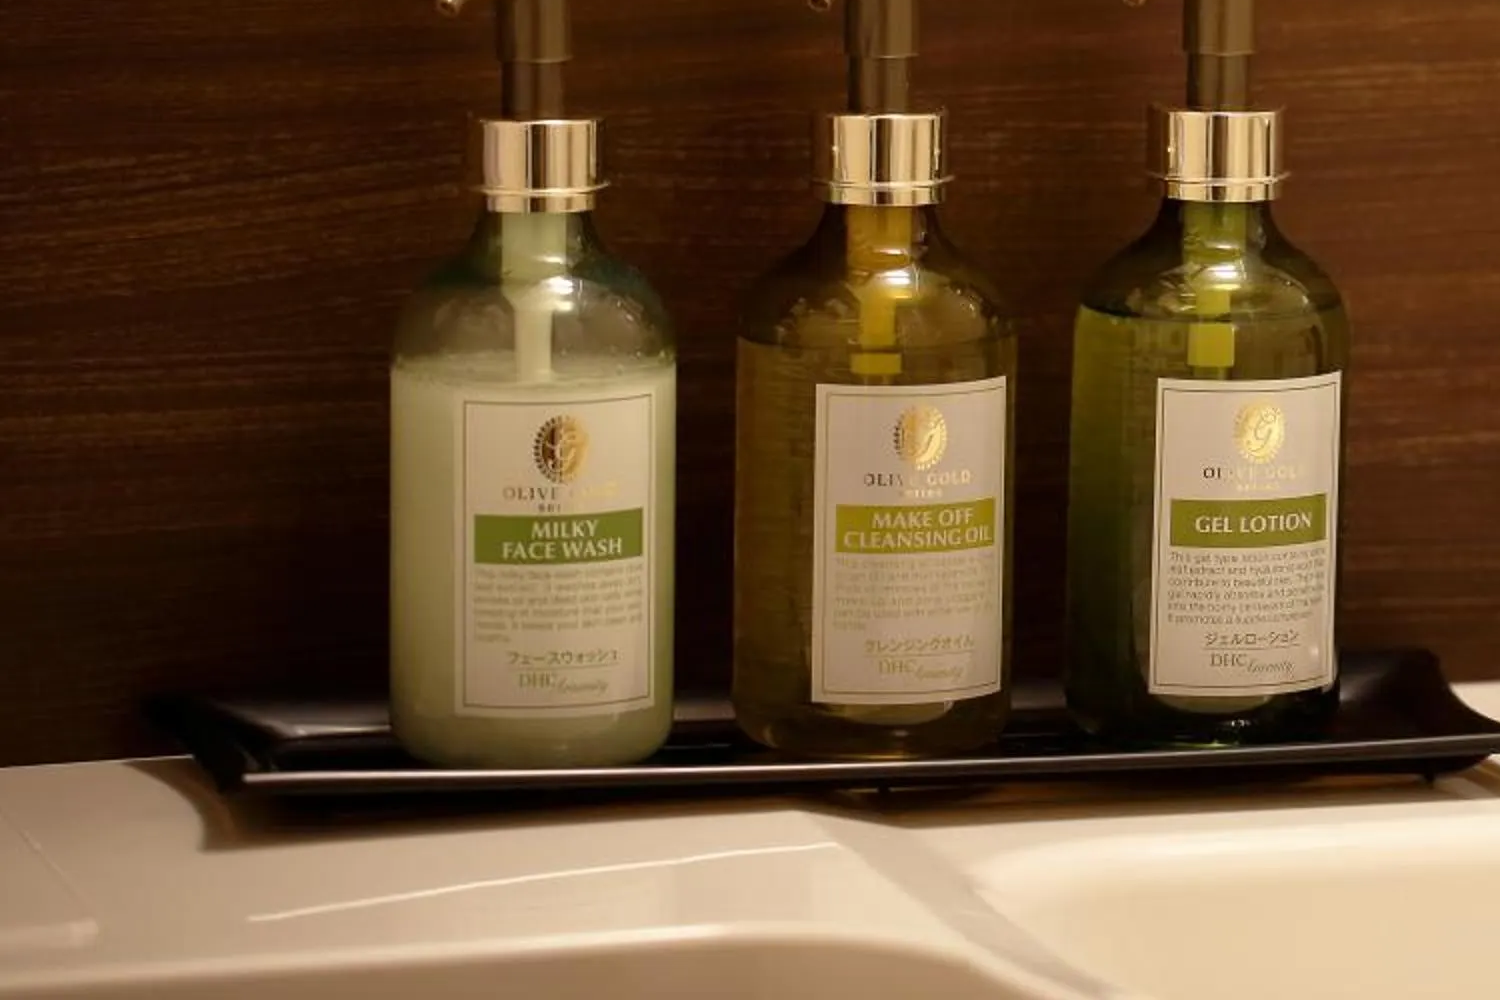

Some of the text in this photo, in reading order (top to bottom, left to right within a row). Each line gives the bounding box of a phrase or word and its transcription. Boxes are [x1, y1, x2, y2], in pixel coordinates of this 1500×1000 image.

[871, 507, 974, 529] MAKE OFF
[1195, 510, 1312, 534] GEL LOTION
[531, 519, 599, 540] MILKY
[844, 525, 993, 550] CLEANSING OIL
[501, 536, 623, 560] FACE WASH
[1203, 629, 1300, 646] ジェルローション
[878, 659, 916, 674] DHC
[1209, 653, 1247, 668] DHC
[518, 672, 557, 688] DHC
